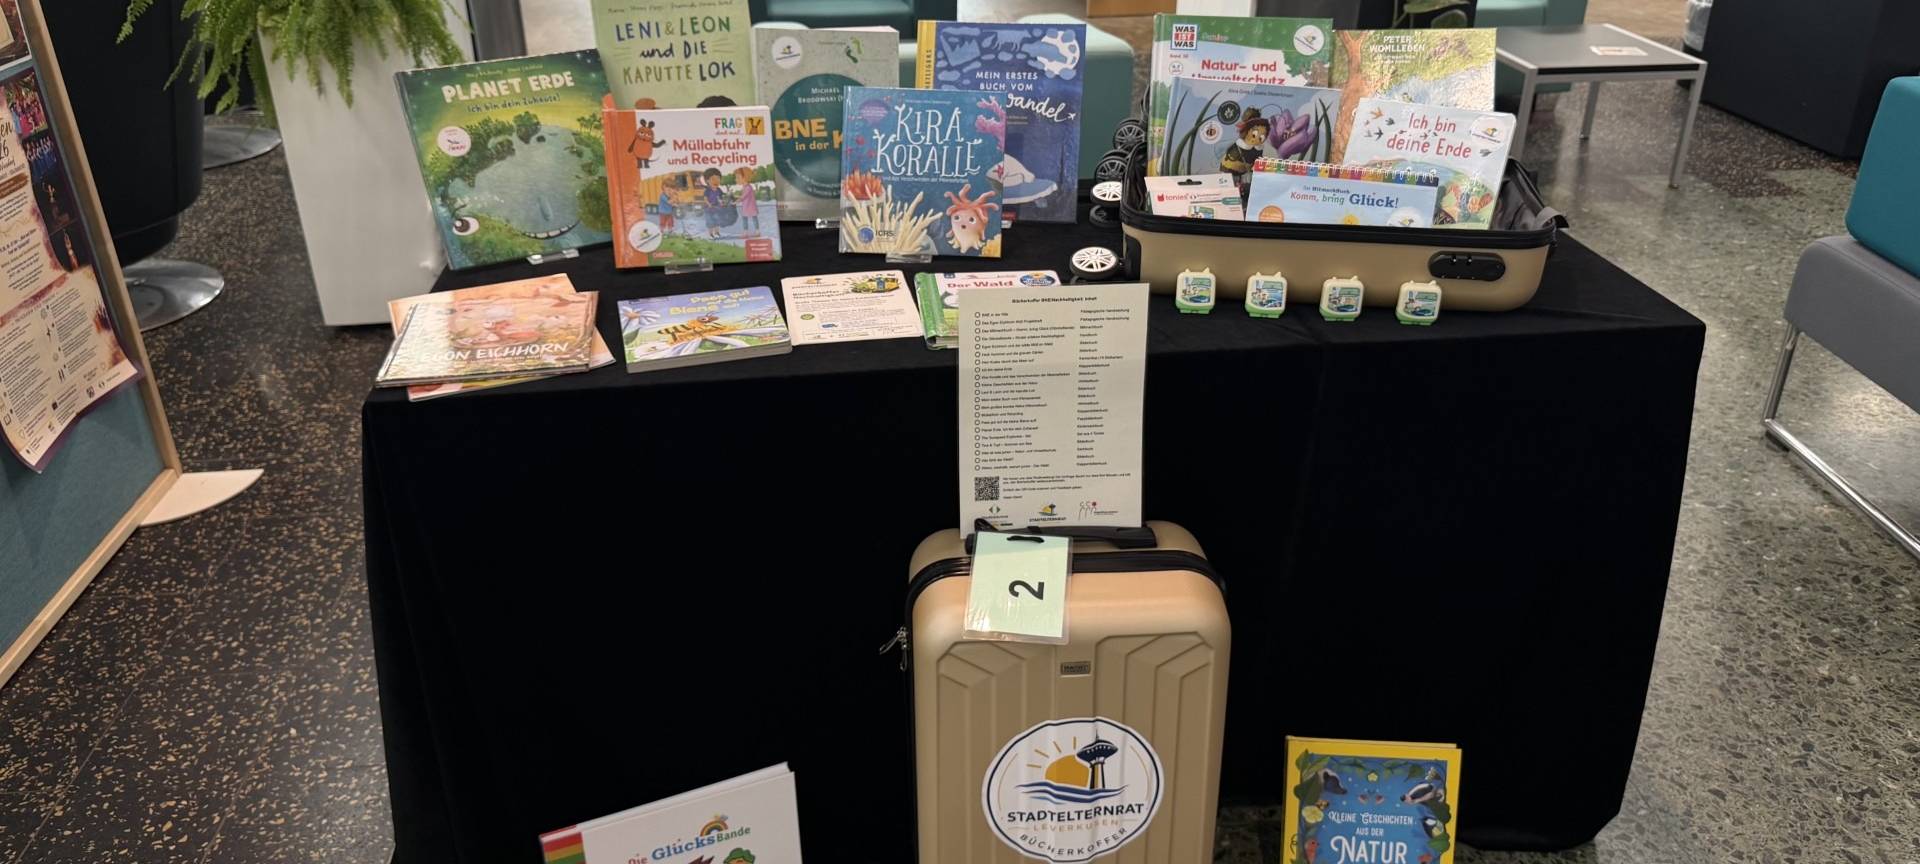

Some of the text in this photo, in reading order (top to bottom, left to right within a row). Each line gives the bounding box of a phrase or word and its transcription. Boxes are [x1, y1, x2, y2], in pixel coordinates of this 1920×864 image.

[615, 16, 731, 42] LENI & LEON
[1383, 35, 1412, 43] PETER
[640, 40, 708, 58] und DIE
[1370, 44, 1425, 53] WOHLLEBEN
[623, 61, 736, 85] KAPUTTE LOK
[1201, 59, 1277, 72] Natur- und
[975, 71, 1038, 80] MEIN ERSTES
[441, 71, 575, 103] PLANET ERDE
[979, 82, 1033, 91] BUCH VOM
[466, 105, 482, 113] Ich
[484, 102, 500, 112] bin
[502, 99, 521, 110] dein
[714, 118, 742, 129] FRAG
[774, 118, 828, 140] BNE
[894, 104, 965, 145] KIRA
[1408, 112, 1456, 133] Ich bin
[673, 139, 751, 151] Müllabfuhr
[795, 141, 806, 151] in
[809, 140, 829, 150] der
[871, 128, 983, 178] KORALLE
[1386, 134, 1430, 153] deine
[1436, 136, 1471, 158] Erde
[668, 152, 757, 166] und Recycling
[1290, 192, 1399, 209] Komm, bring Glück!
[973, 280, 1013, 288] Wald
[670, 304, 718, 315] Biene
[422, 342, 569, 363] EGON EICHHORN
[1008, 580, 1045, 601] 2
[1007, 803, 1144, 822] STADTELTERNRAT
[1328, 810, 1413, 825] KLEINE GESCHICHTEN
[1033, 820, 1119, 832] LEVERKUSEN
[1355, 827, 1384, 836] AUS DER
[1019, 826, 1127, 856] BÜCHERKOFFER
[1330, 835, 1407, 864] NATUR
